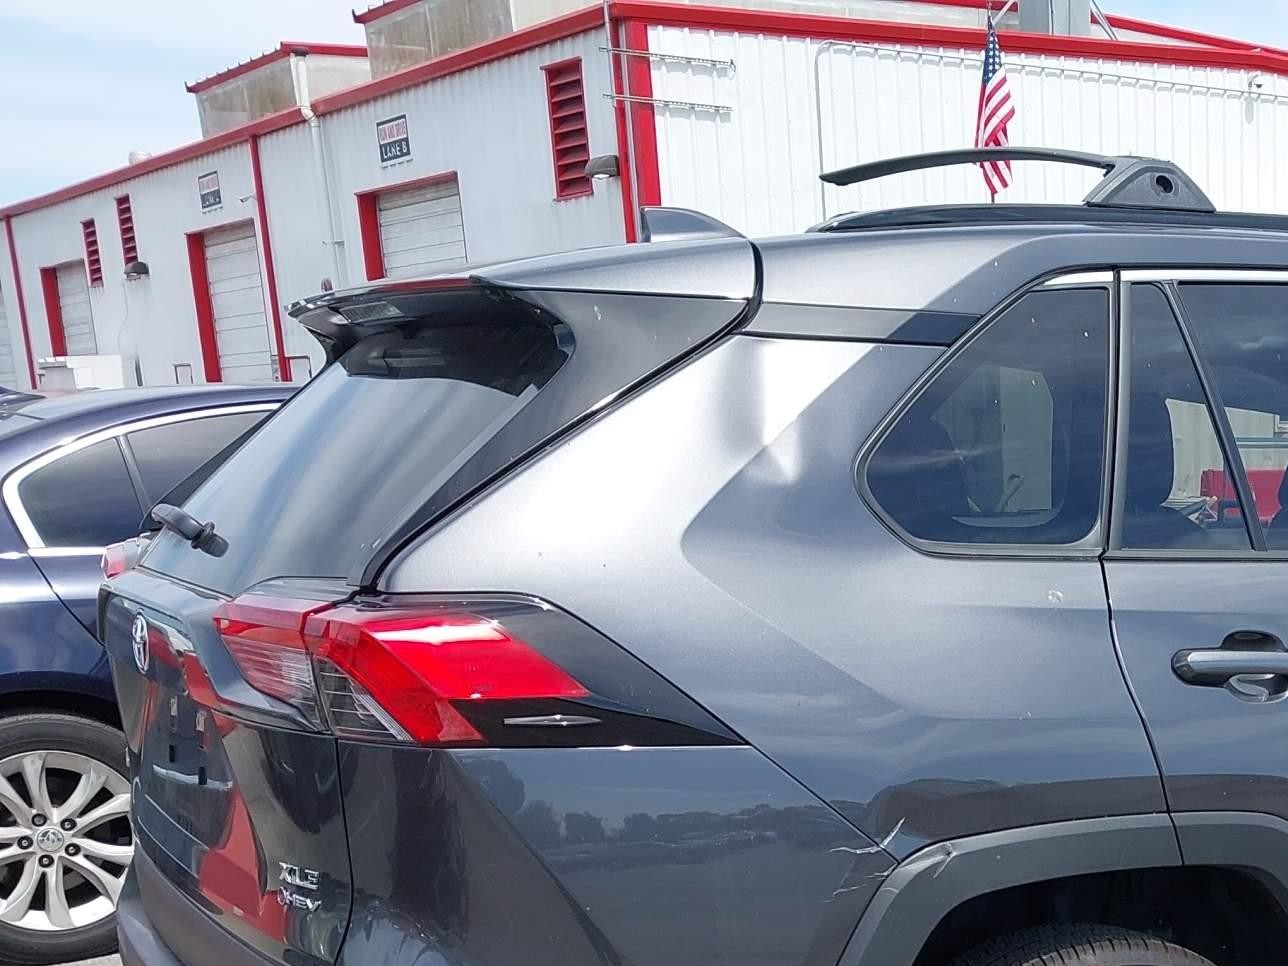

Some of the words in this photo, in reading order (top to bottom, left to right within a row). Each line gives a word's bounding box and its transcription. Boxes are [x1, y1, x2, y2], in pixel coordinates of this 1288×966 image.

[382, 143, 401, 159] LANE
[402, 141, 408, 153] B
[278, 861, 320, 890] XLE
